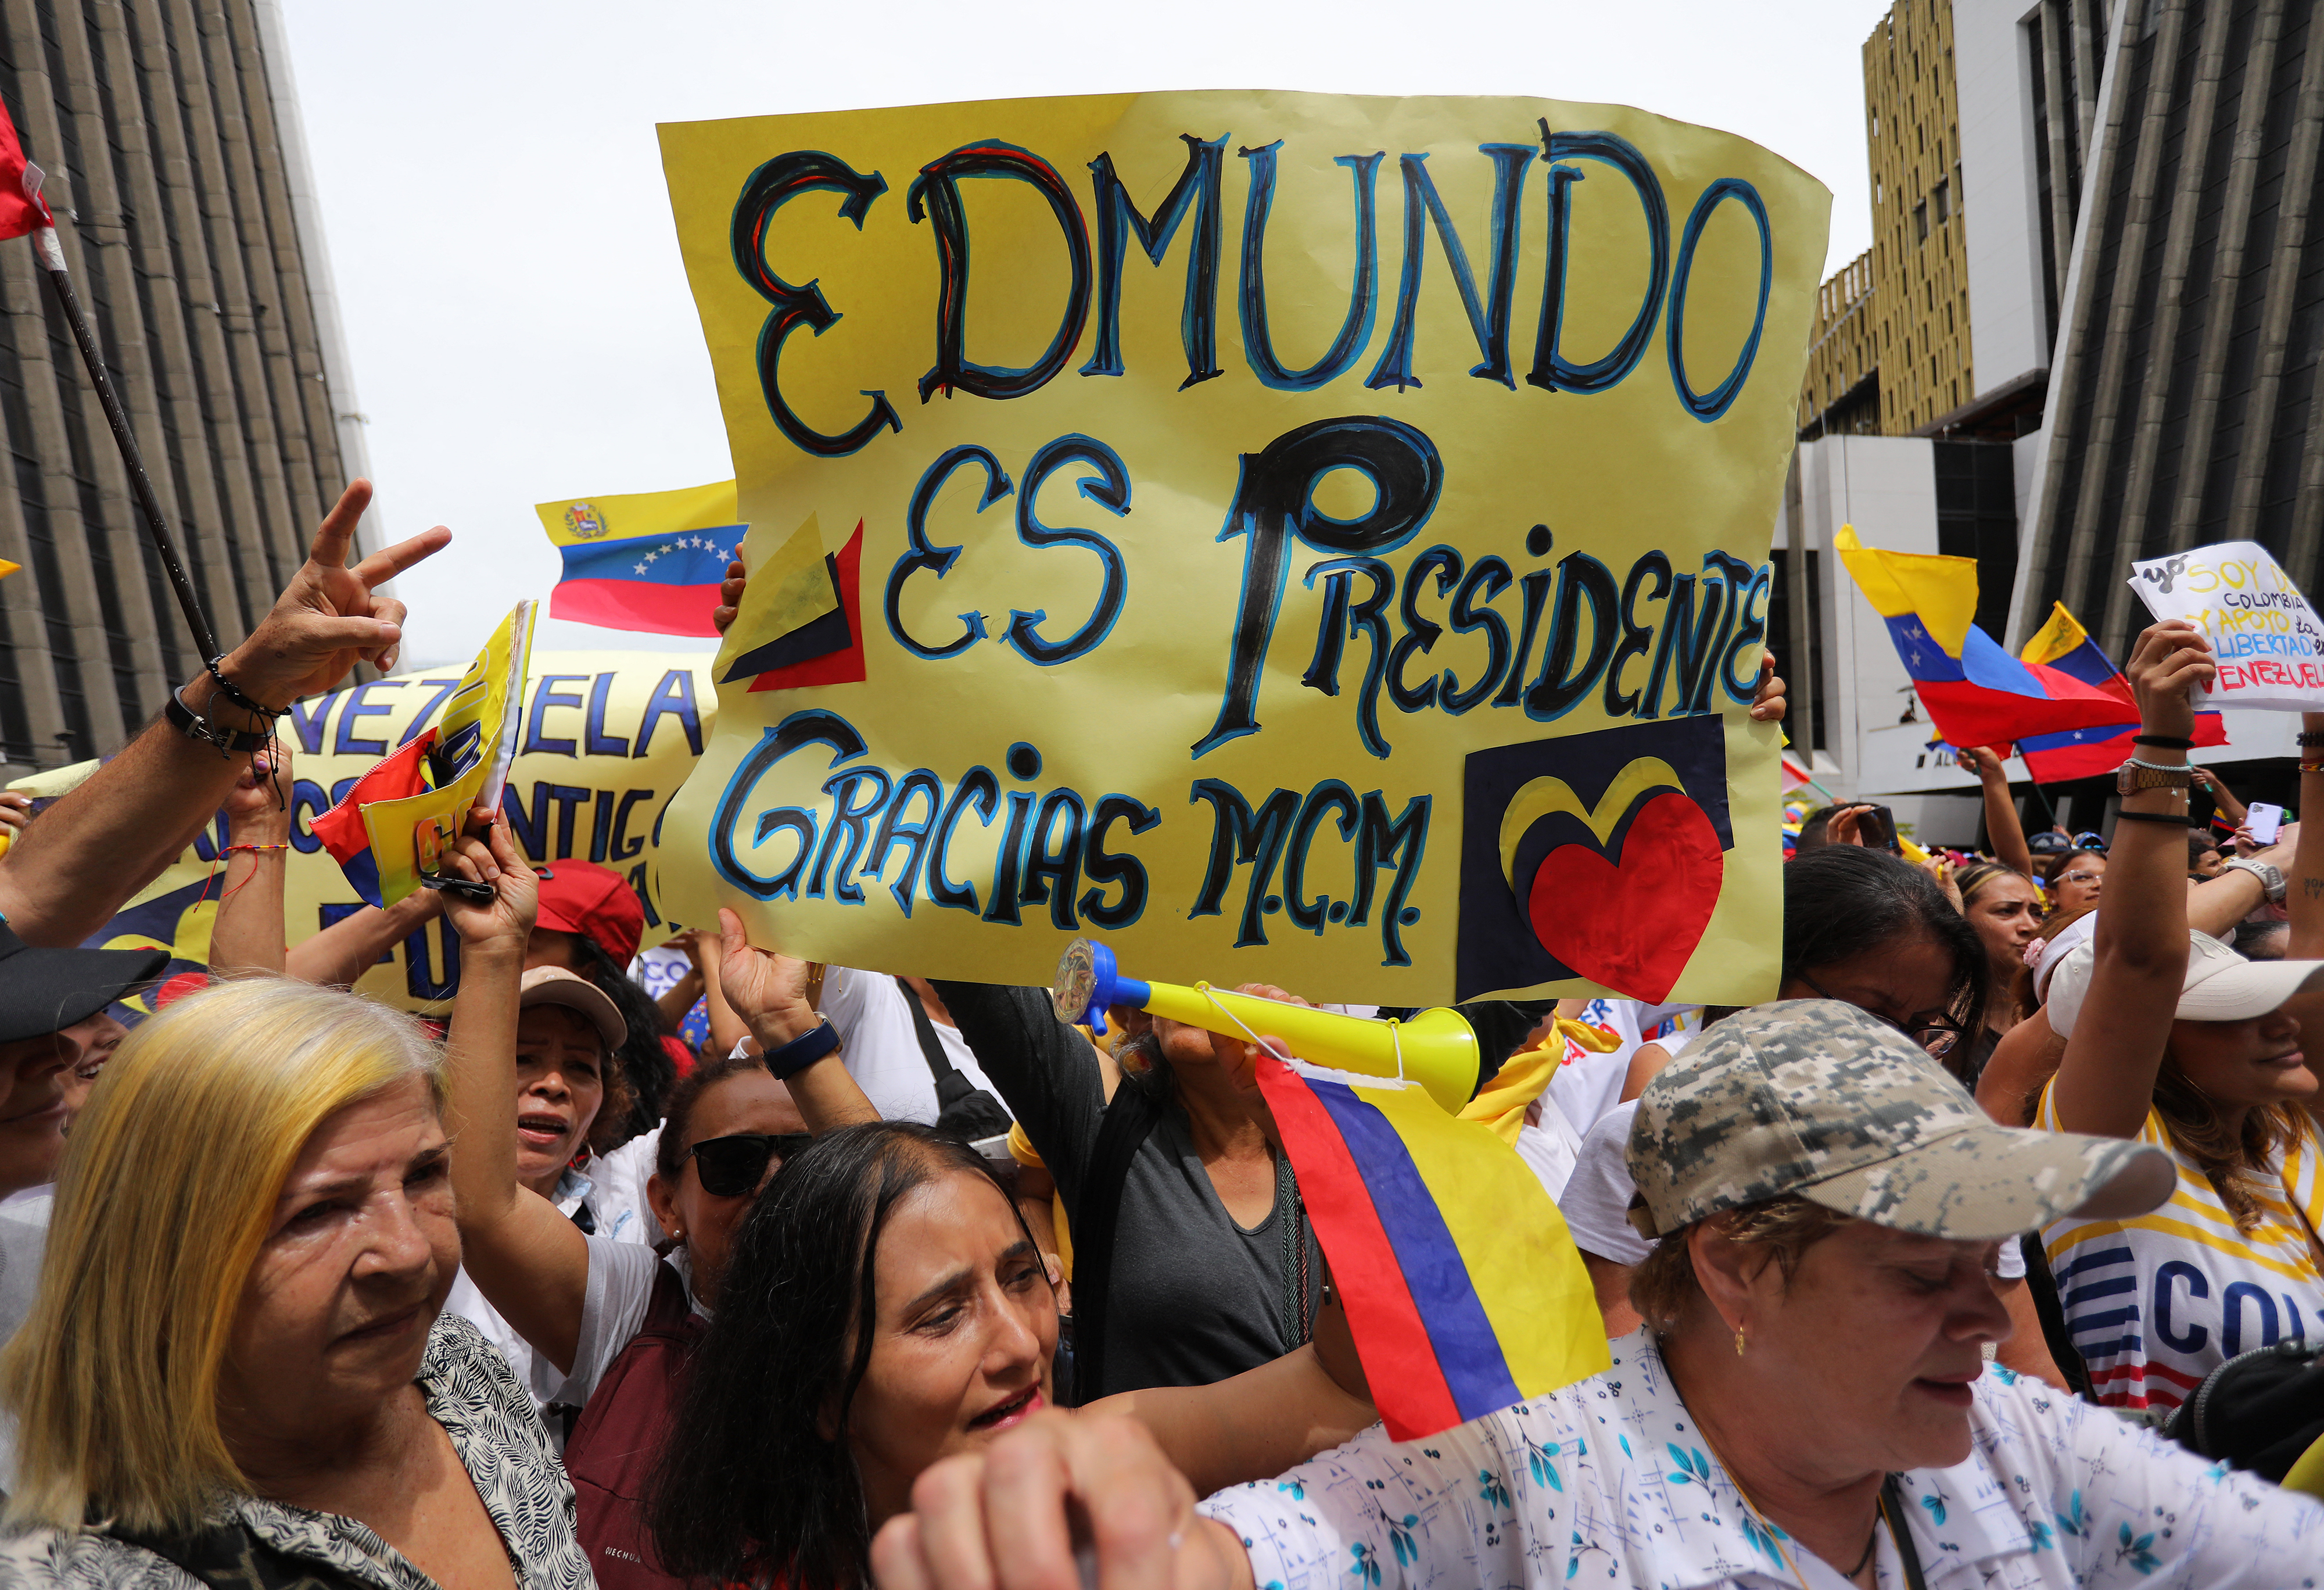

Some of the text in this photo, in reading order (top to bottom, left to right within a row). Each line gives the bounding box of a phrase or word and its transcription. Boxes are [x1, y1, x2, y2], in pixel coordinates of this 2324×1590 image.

[730, 117, 1771, 458] EDMUNDO
[884, 432, 1132, 666] ES
[2186, 560, 2260, 593] SOY
[2223, 592, 2307, 613] COLOMBIA
[2185, 608, 2211, 636] Y
[2218, 608, 2290, 635] APOYO
[2214, 633, 2313, 658] LIBERTAD
[2199, 660, 2324, 695] VENEZUEL
[1187, 777, 1433, 967] M.C.M.
